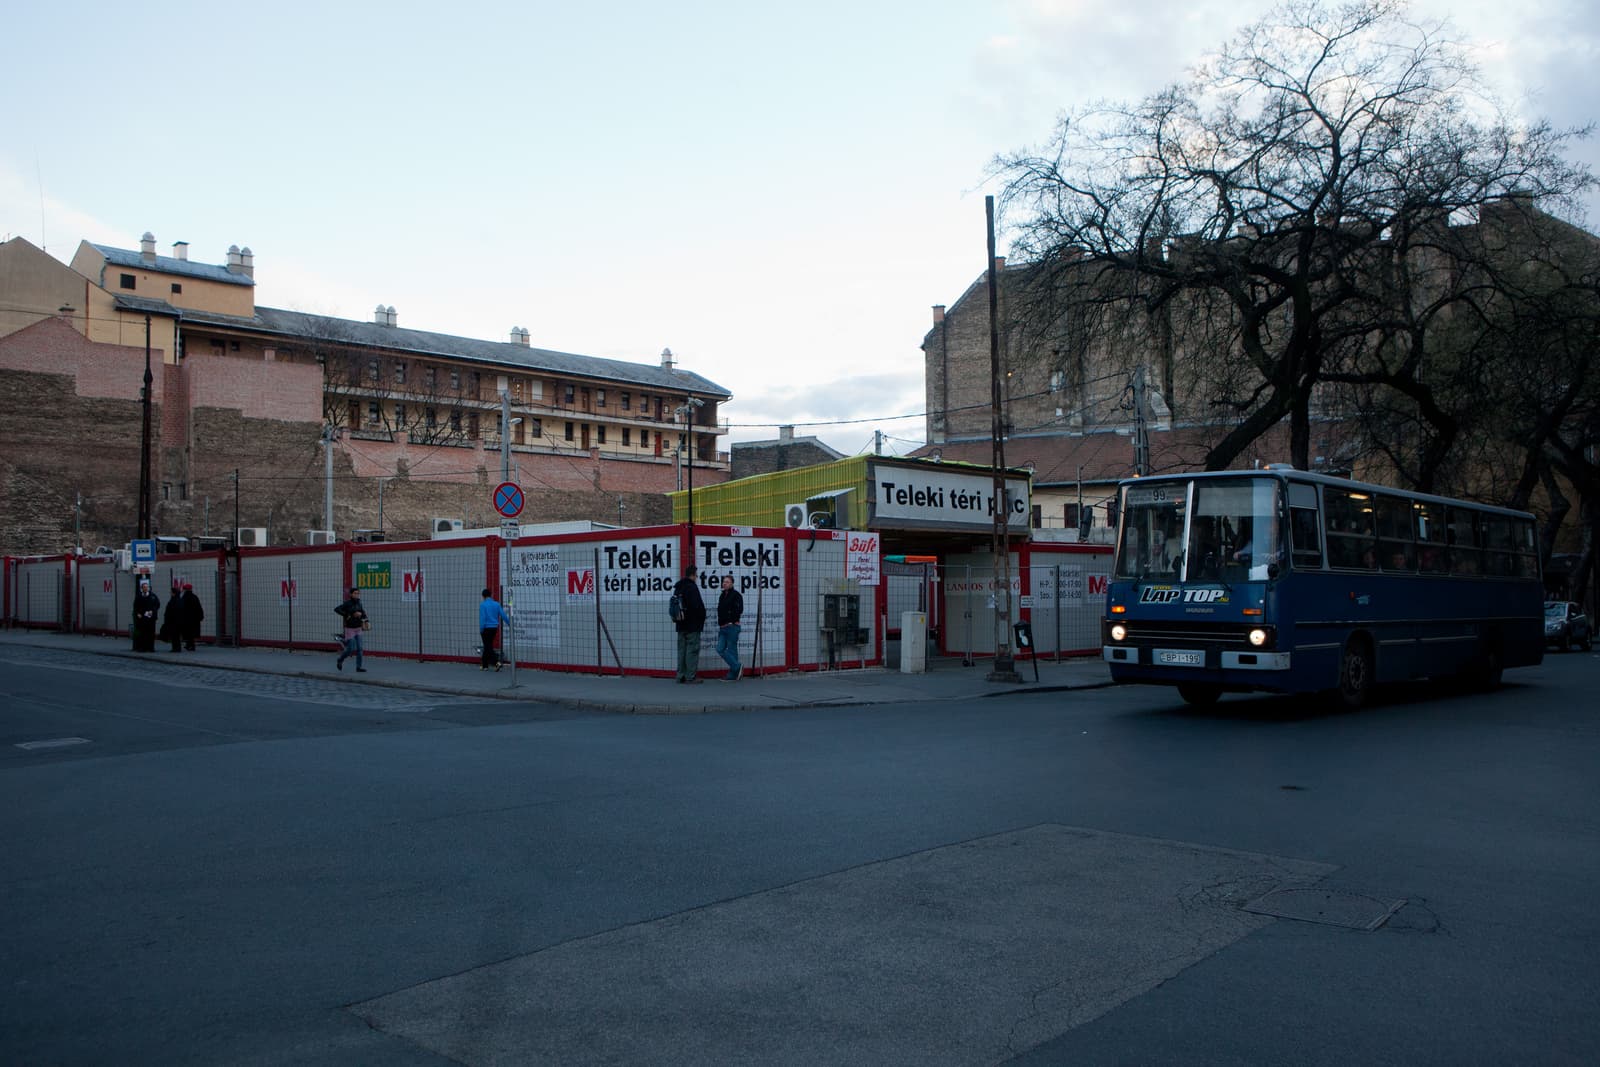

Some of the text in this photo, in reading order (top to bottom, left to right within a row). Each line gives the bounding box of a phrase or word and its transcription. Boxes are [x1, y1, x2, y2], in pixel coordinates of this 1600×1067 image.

[882, 482, 943, 507] Teleki
[949, 489, 981, 510] téri
[1153, 489, 1165, 501] 99
[700, 541, 779, 566] Teleki
[850, 537, 876, 554] Büfé
[604, 543, 671, 569] Teleki
[526, 563, 559, 573] 6:00-17:00
[358, 569, 389, 587] BÜFÉ
[526, 577, 559, 586] 6:00-14:00
[604, 571, 673, 596] téri piac
[741, 571, 780, 594] piac
[1140, 587, 1180, 603] LAP
[1184, 590, 1224, 602] TOP
